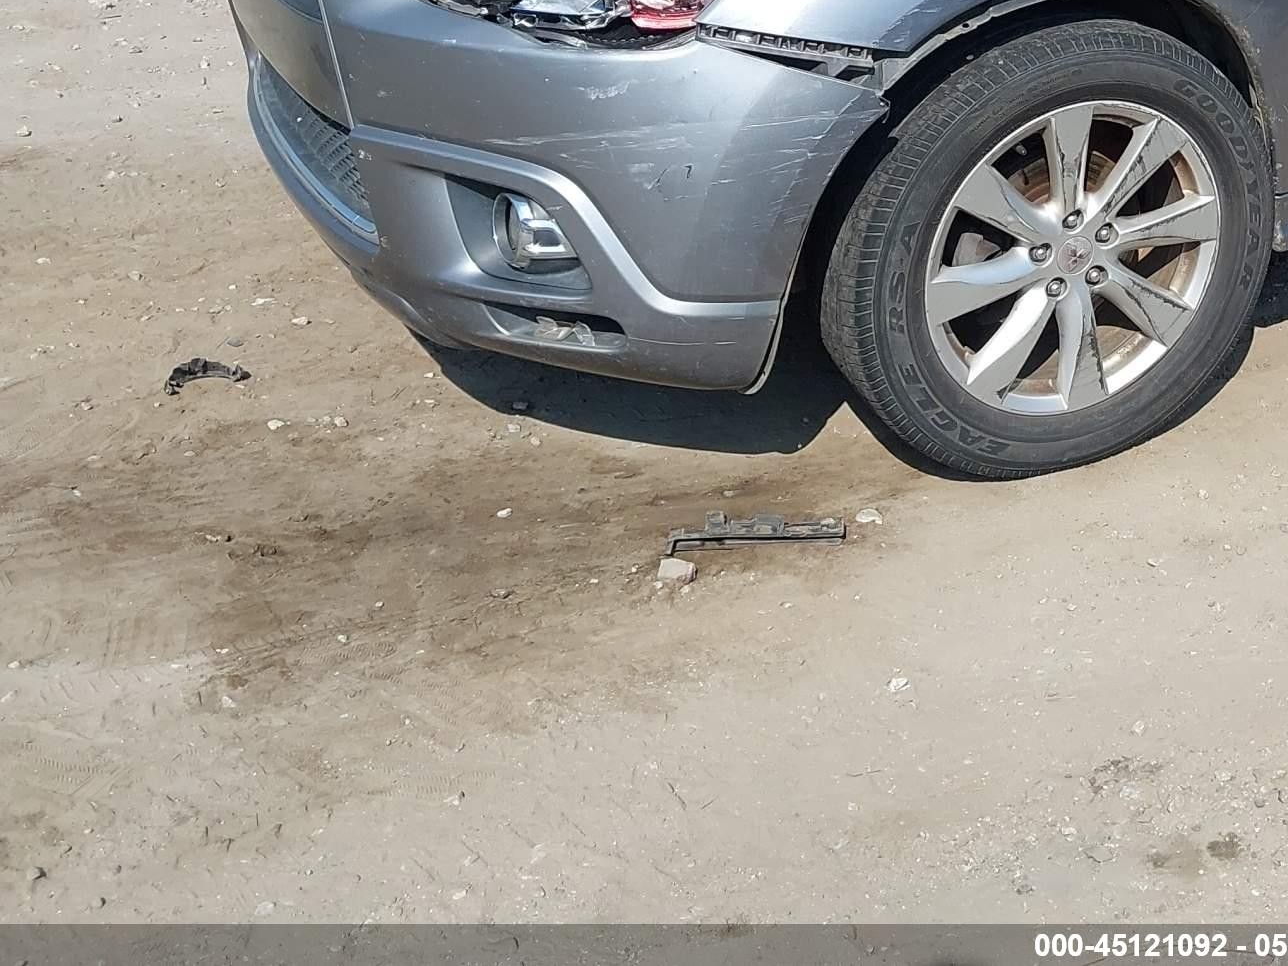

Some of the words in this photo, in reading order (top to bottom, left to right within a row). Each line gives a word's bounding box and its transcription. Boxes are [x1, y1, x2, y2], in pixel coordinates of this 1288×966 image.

[1172, 78, 1263, 290] GOODYEAR
[886, 221, 922, 335] RS-A
[897, 361, 1012, 457] EAGLE
